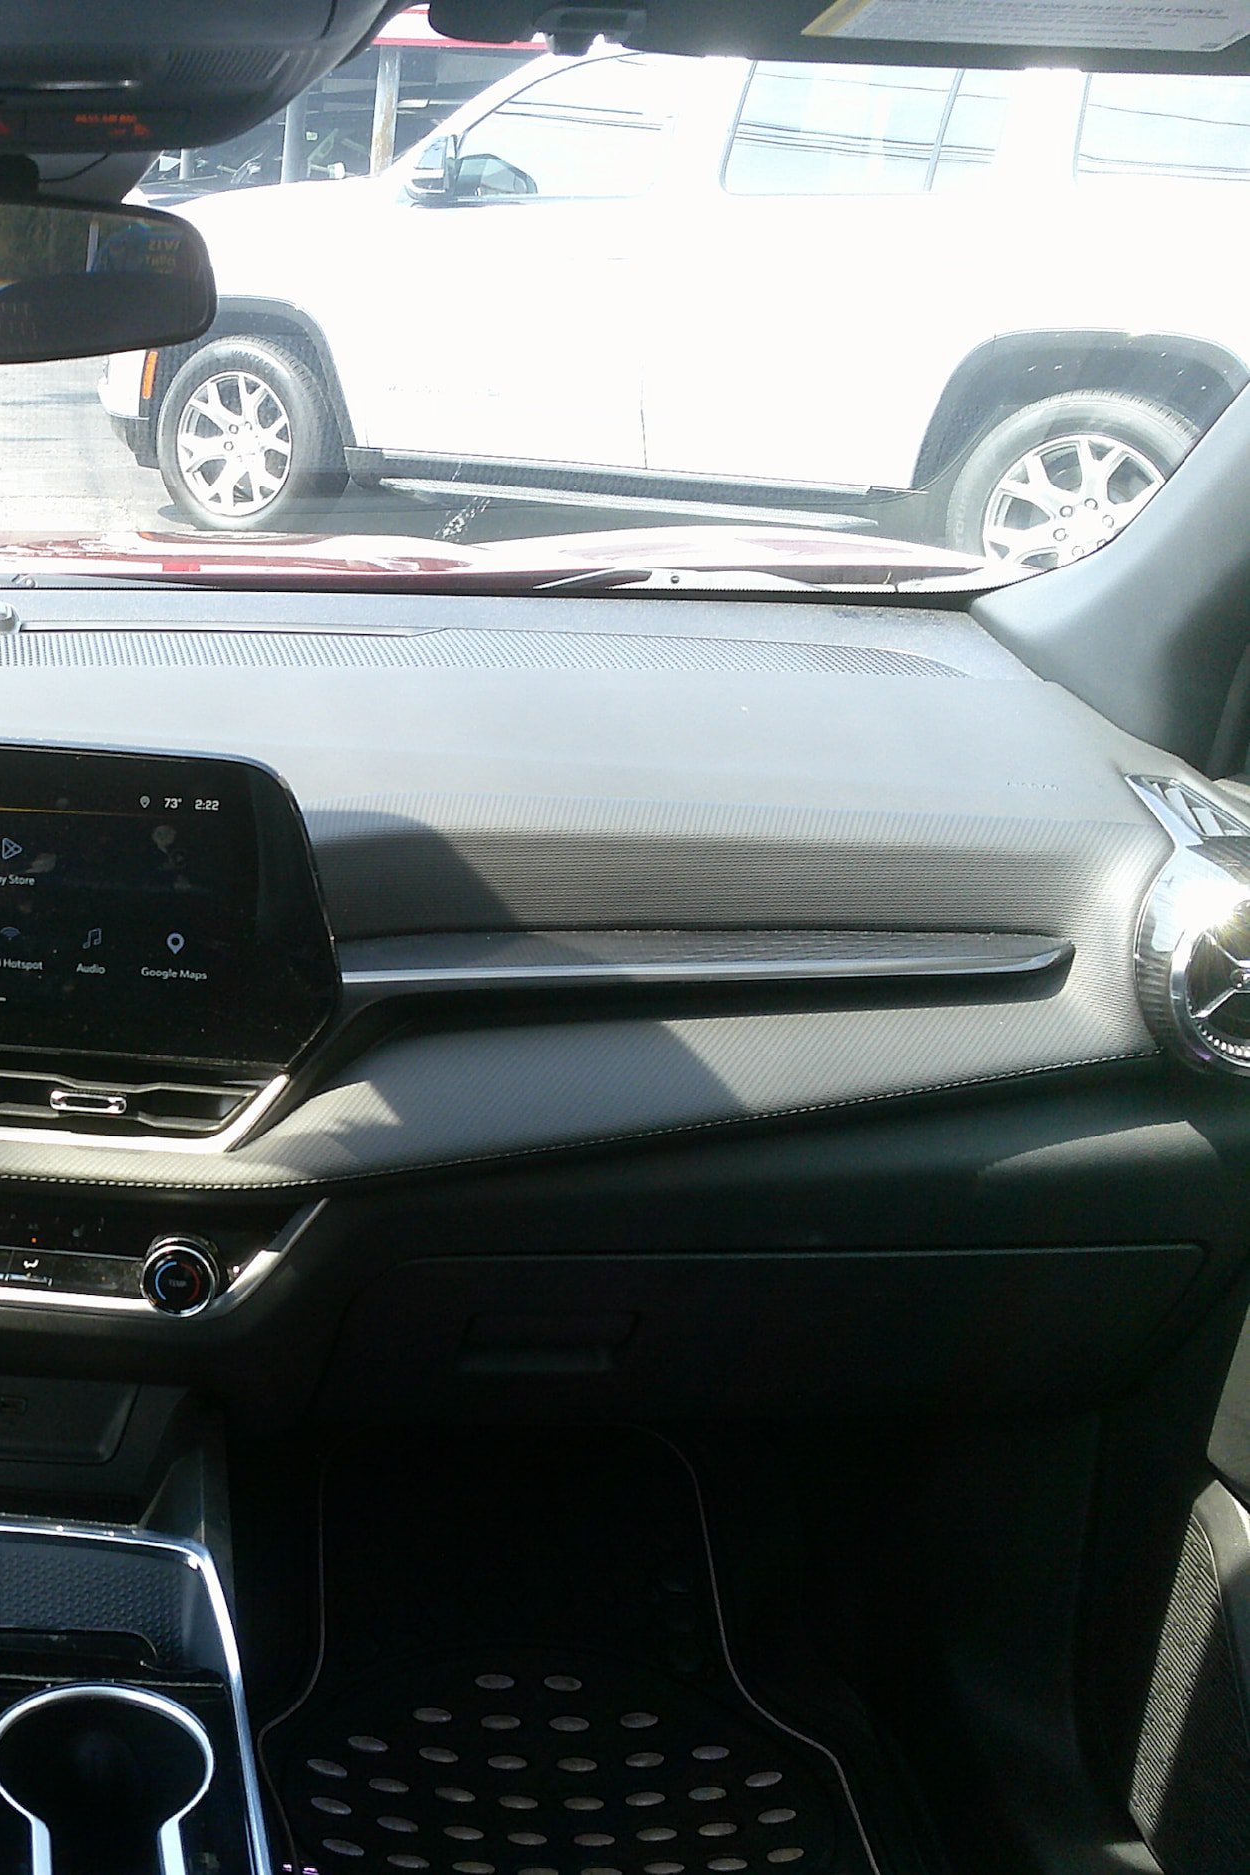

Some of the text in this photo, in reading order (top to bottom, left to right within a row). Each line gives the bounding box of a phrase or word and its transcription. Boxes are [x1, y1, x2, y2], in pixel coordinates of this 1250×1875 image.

[163, 797, 220, 811] 73° 2:22
[9, 875, 35, 886] Store
[2, 958, 43, 972] Hotspot
[76, 962, 106, 975] Audio
[140, 966, 208, 982] Google Maps
